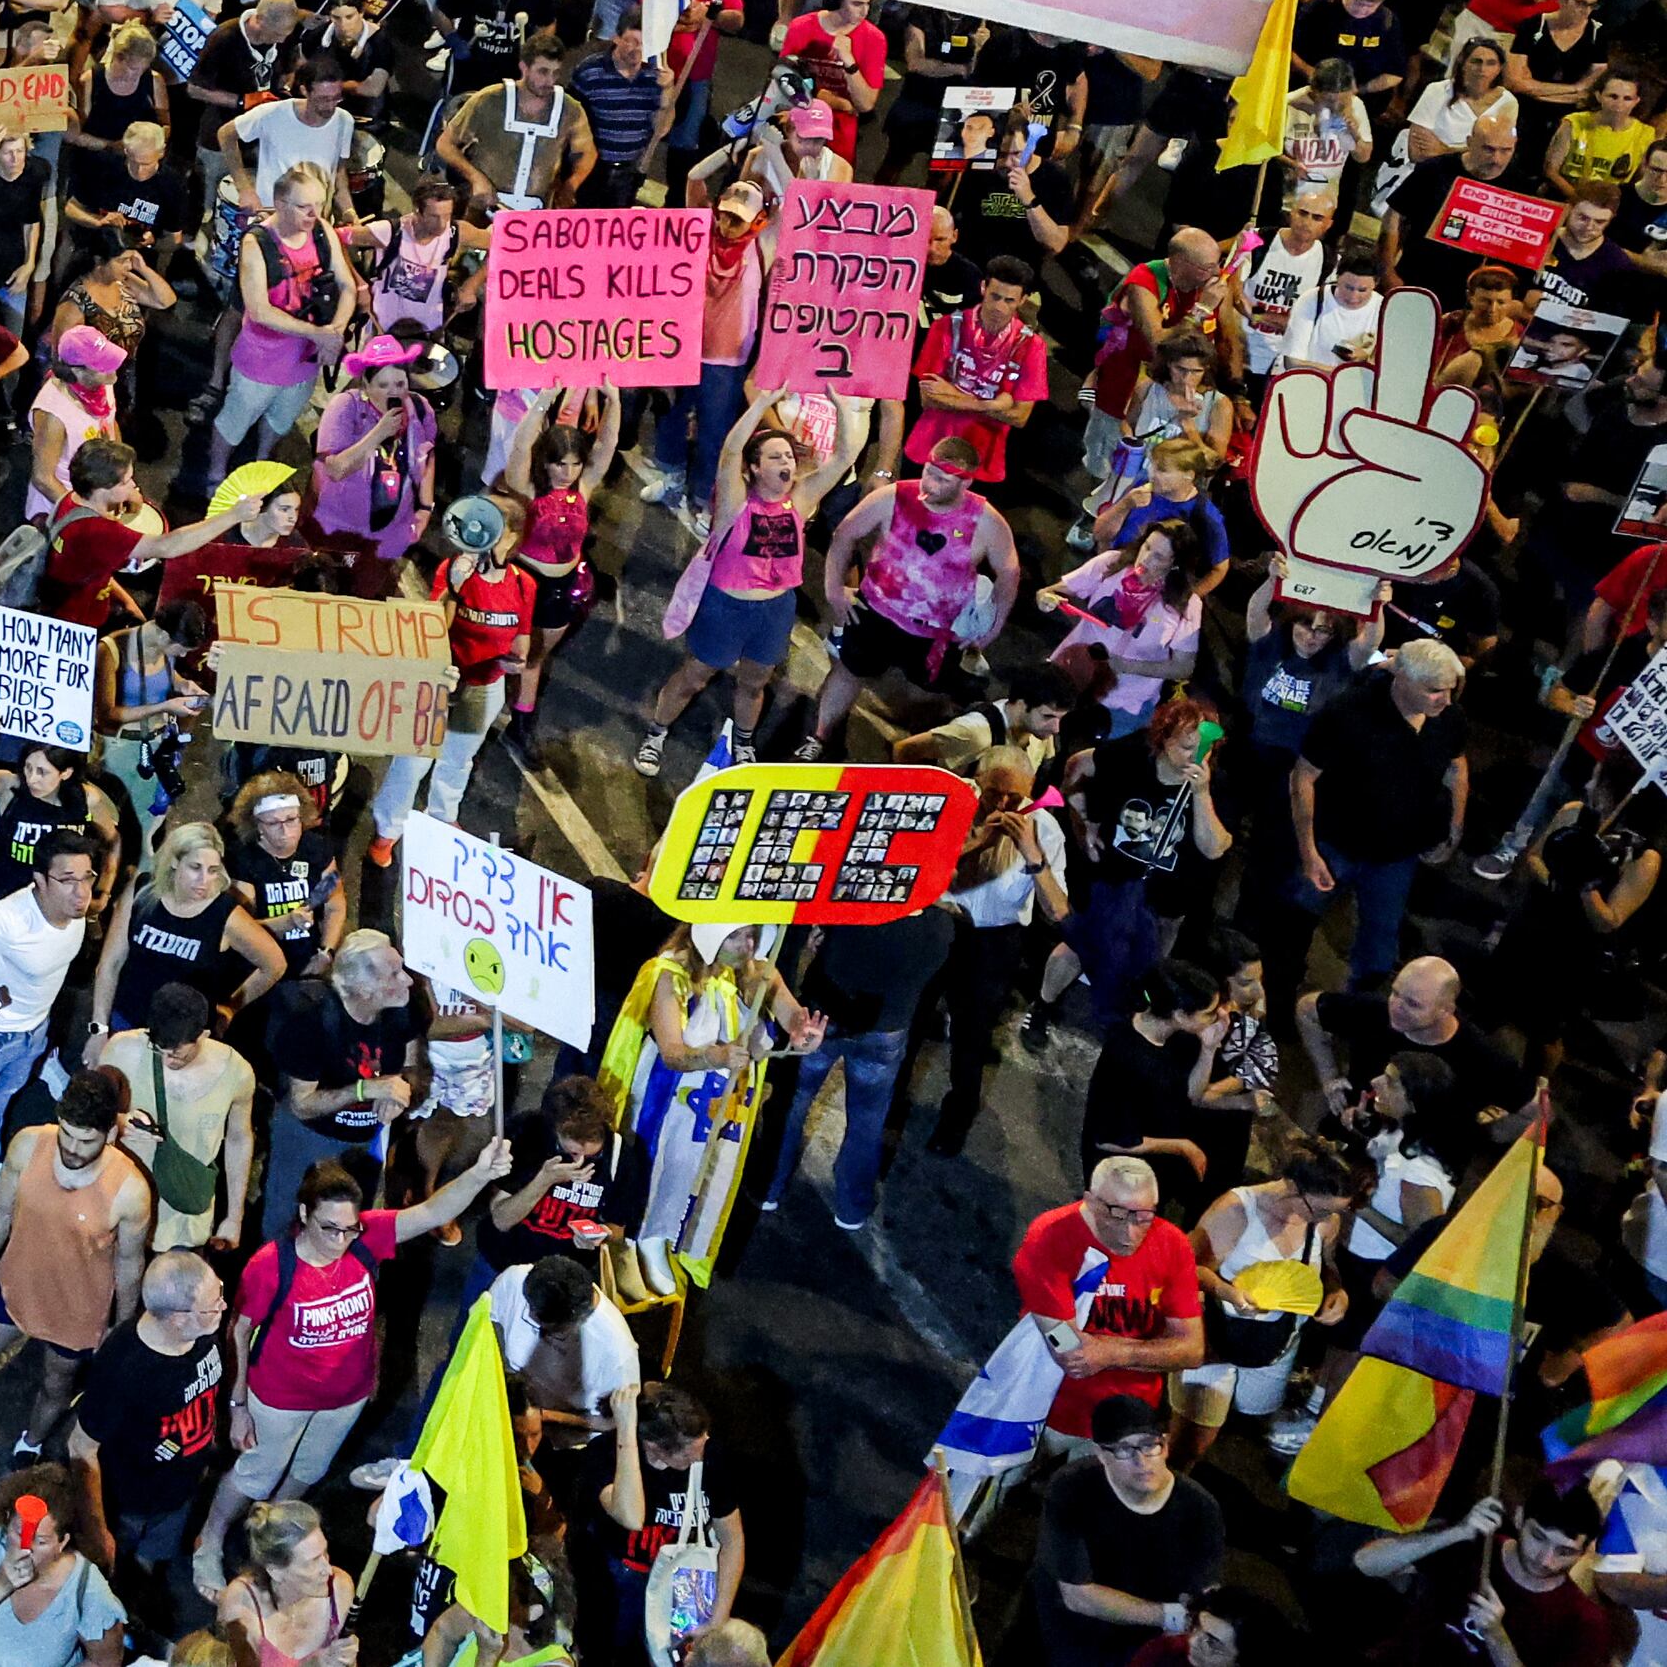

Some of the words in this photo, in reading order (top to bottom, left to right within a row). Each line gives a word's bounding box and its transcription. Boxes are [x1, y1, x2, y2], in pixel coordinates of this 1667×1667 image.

[167, 9, 207, 44] STOP
[794, 194, 917, 238] מבצע
[1466, 187, 1492, 202] END
[503, 215, 704, 254] SABOTAGING
[499, 260, 582, 301] DEALS
[605, 258, 693, 298] KILLS
[786, 250, 917, 295] הפקרת
[1267, 268, 1302, 286] אתה
[505, 318, 682, 364] HOSTAGES
[769, 300, 913, 340] החטופים
[1349, 528, 1433, 571] נמאס
[3, 614, 41, 646] HOW
[48, 616, 96, 651] MANY
[216, 587, 279, 646] IS
[314, 598, 447, 658] TRUMP
[57, 660, 89, 692] FOR
[216, 675, 350, 740] AFRAID
[359, 680, 404, 730] OF
[451, 838, 514, 905] צדיק
[537, 876, 574, 930] אין
[303, 1291, 370, 1329] PINKFRONT
